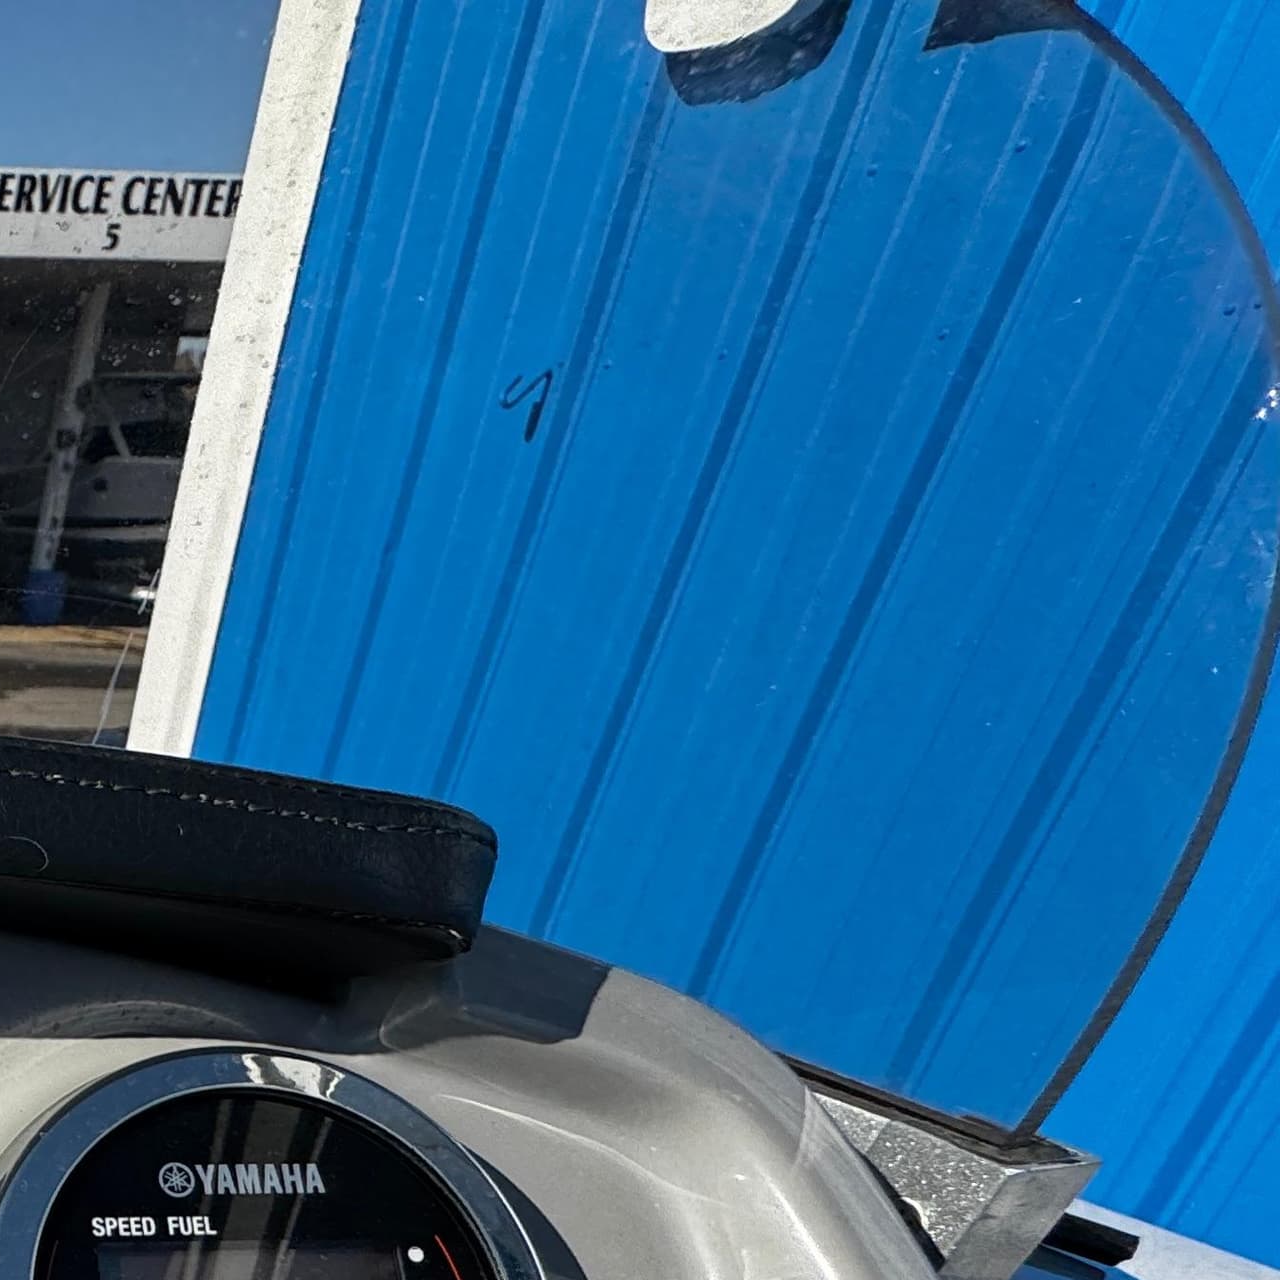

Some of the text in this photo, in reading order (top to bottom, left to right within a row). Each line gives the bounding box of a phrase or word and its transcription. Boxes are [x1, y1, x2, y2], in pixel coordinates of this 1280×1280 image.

[101, 222, 121, 251] 5
[195, 1162, 327, 1196] YAMAHA
[92, 1215, 218, 1238] SPEED FUEL
